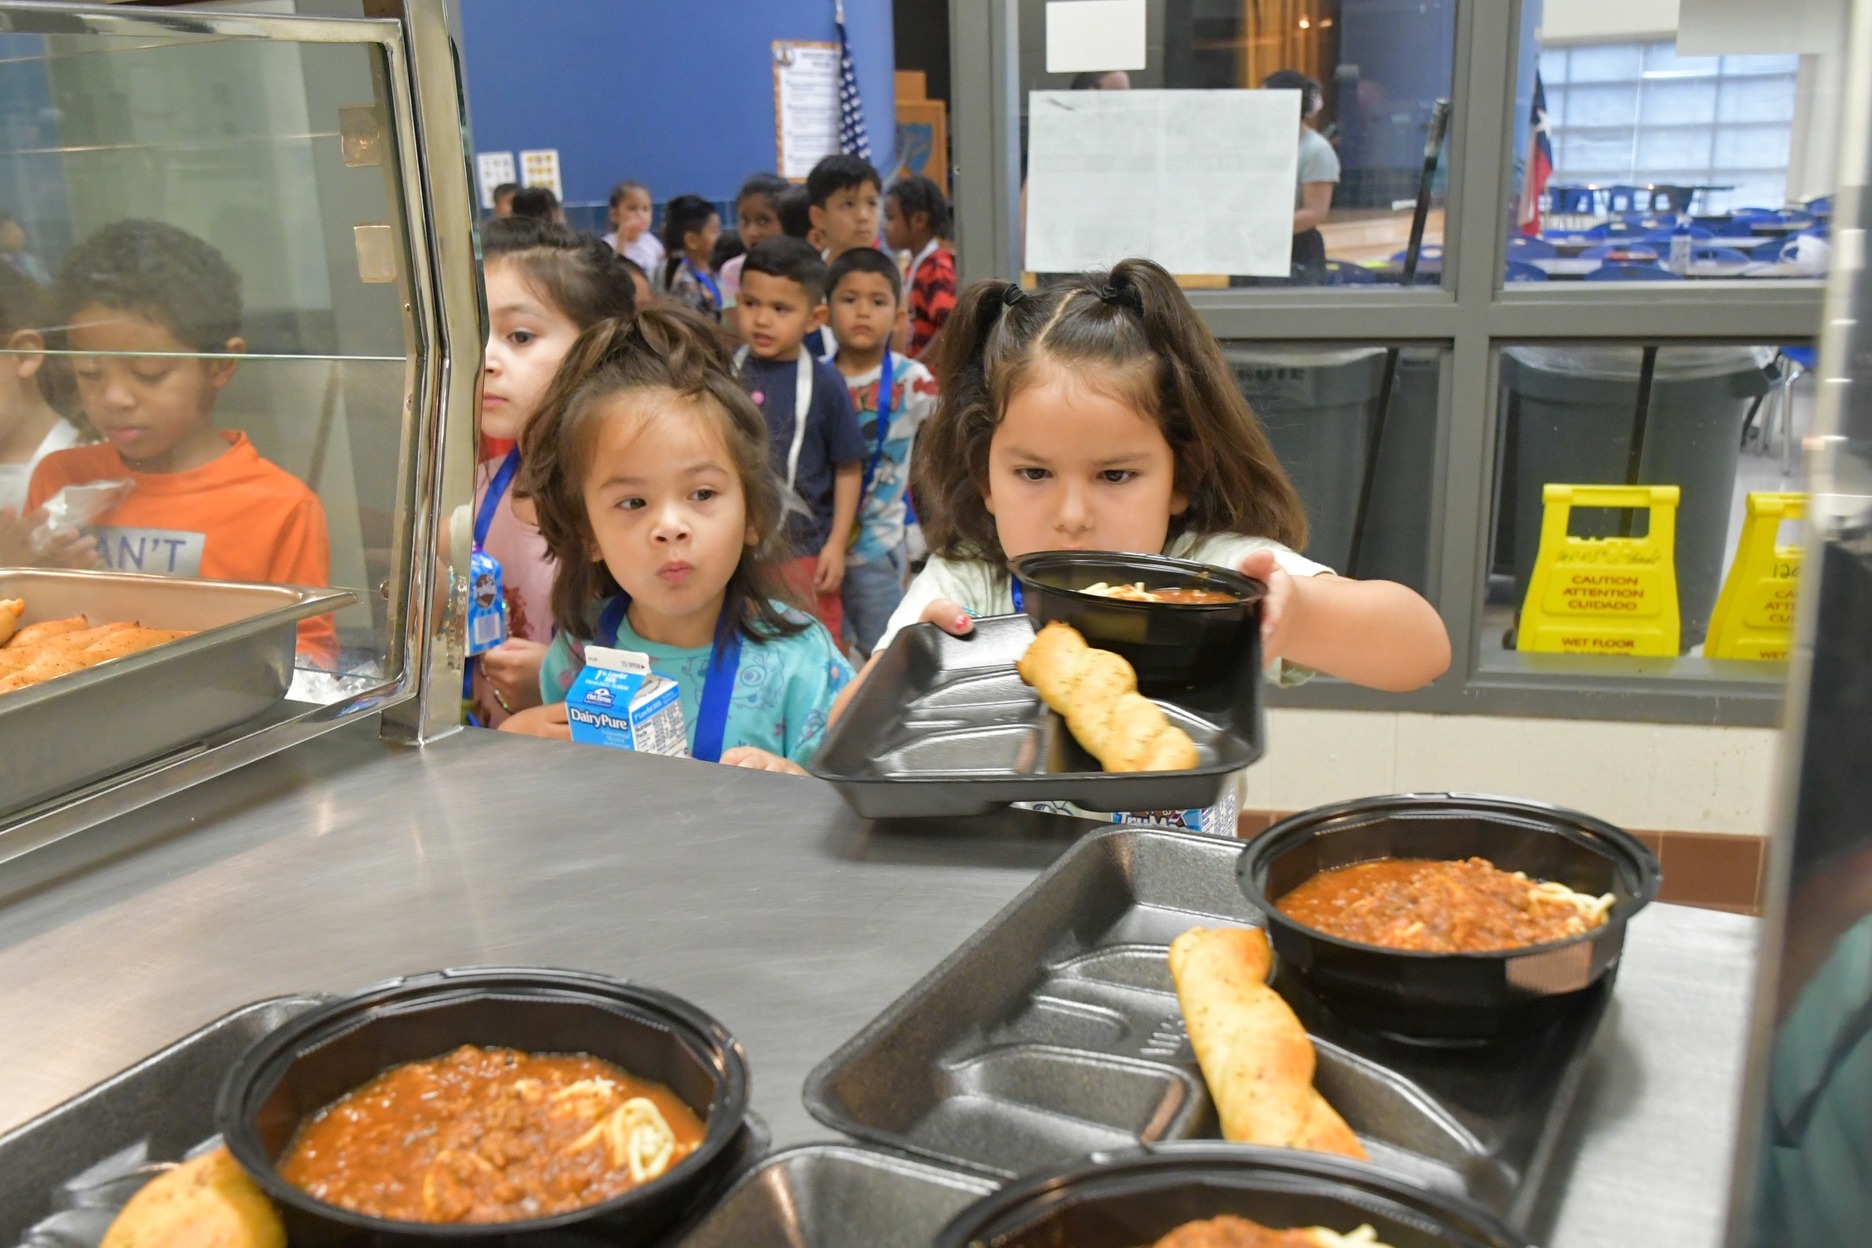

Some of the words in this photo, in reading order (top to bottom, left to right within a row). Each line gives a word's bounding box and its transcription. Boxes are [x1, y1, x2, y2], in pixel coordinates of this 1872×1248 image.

[96, 533, 187, 573] AN'T
[1572, 575, 1639, 586] CAUTION
[1563, 587, 1645, 599] ATTENTION
[1568, 600, 1637, 611] CUIDADO
[1561, 637, 1588, 647] WET
[1592, 638, 1635, 648] FLOOR
[1760, 650, 1787, 659] WET
[570, 707, 629, 730] DairyPure
